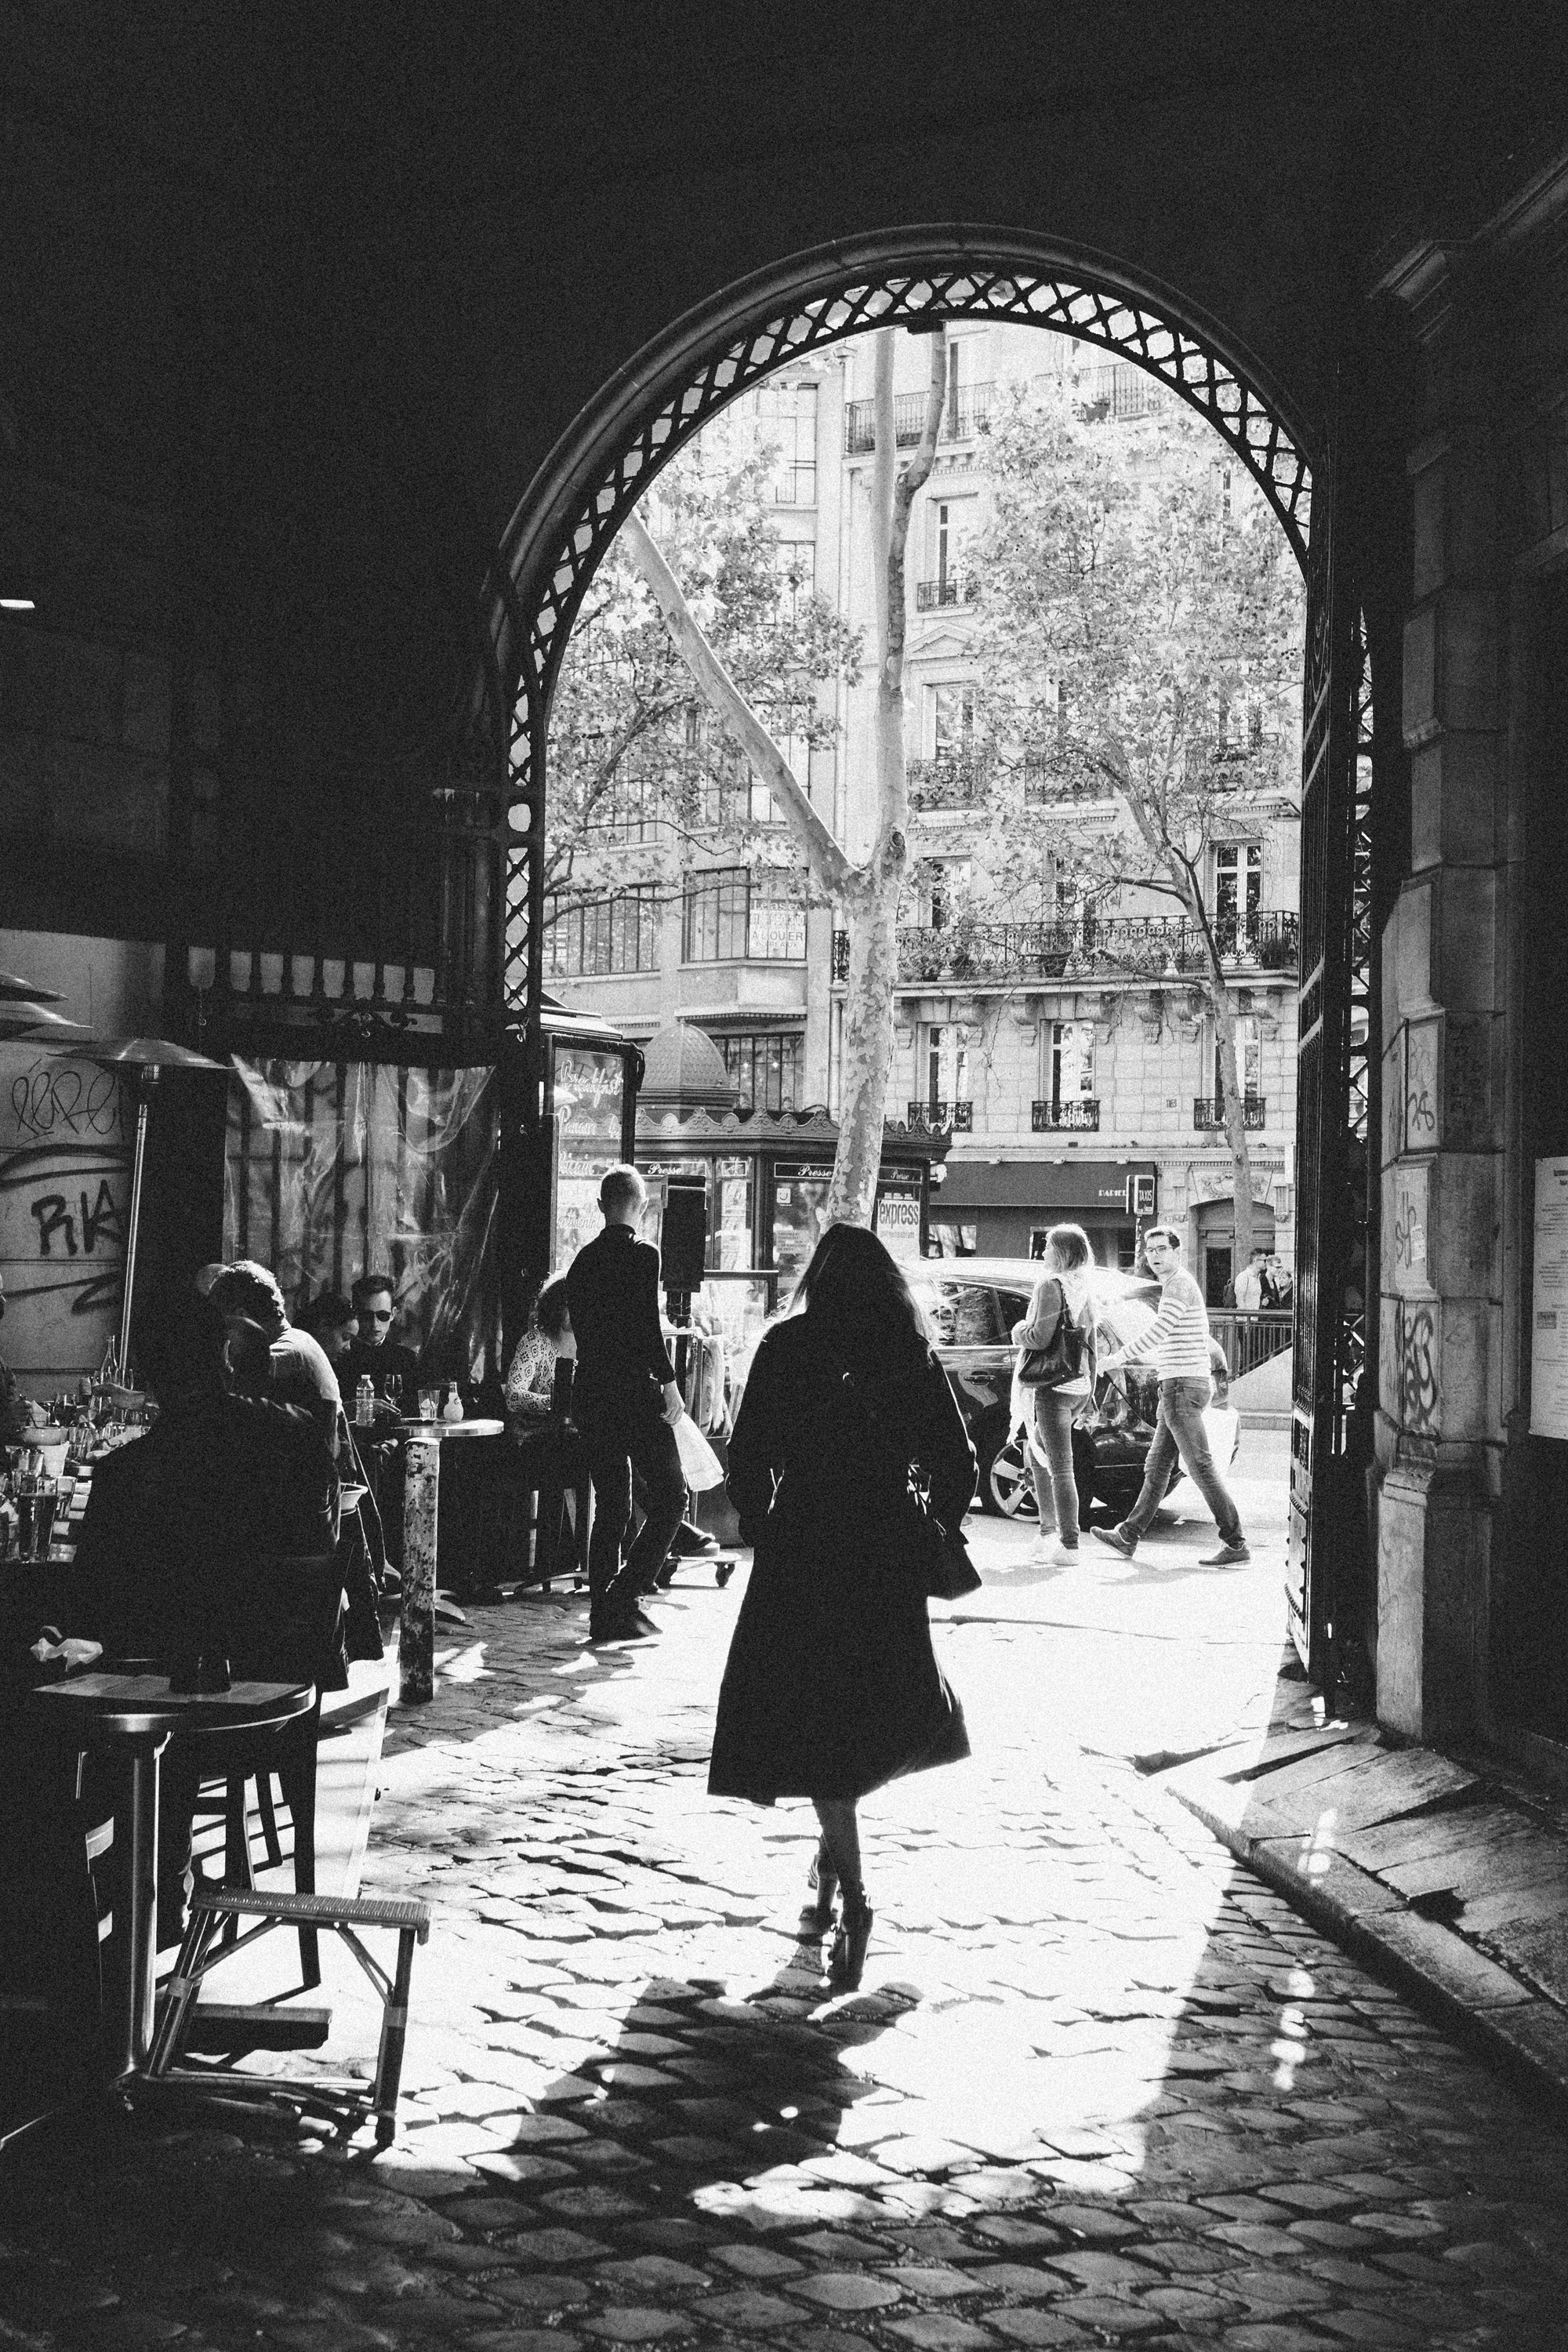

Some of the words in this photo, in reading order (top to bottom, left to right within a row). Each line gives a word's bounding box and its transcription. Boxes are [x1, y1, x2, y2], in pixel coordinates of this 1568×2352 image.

[648, 1163, 682, 1174] Presse
[798, 1165, 833, 1176] Presse
[1138, 1189, 1152, 1202] TAXIS
